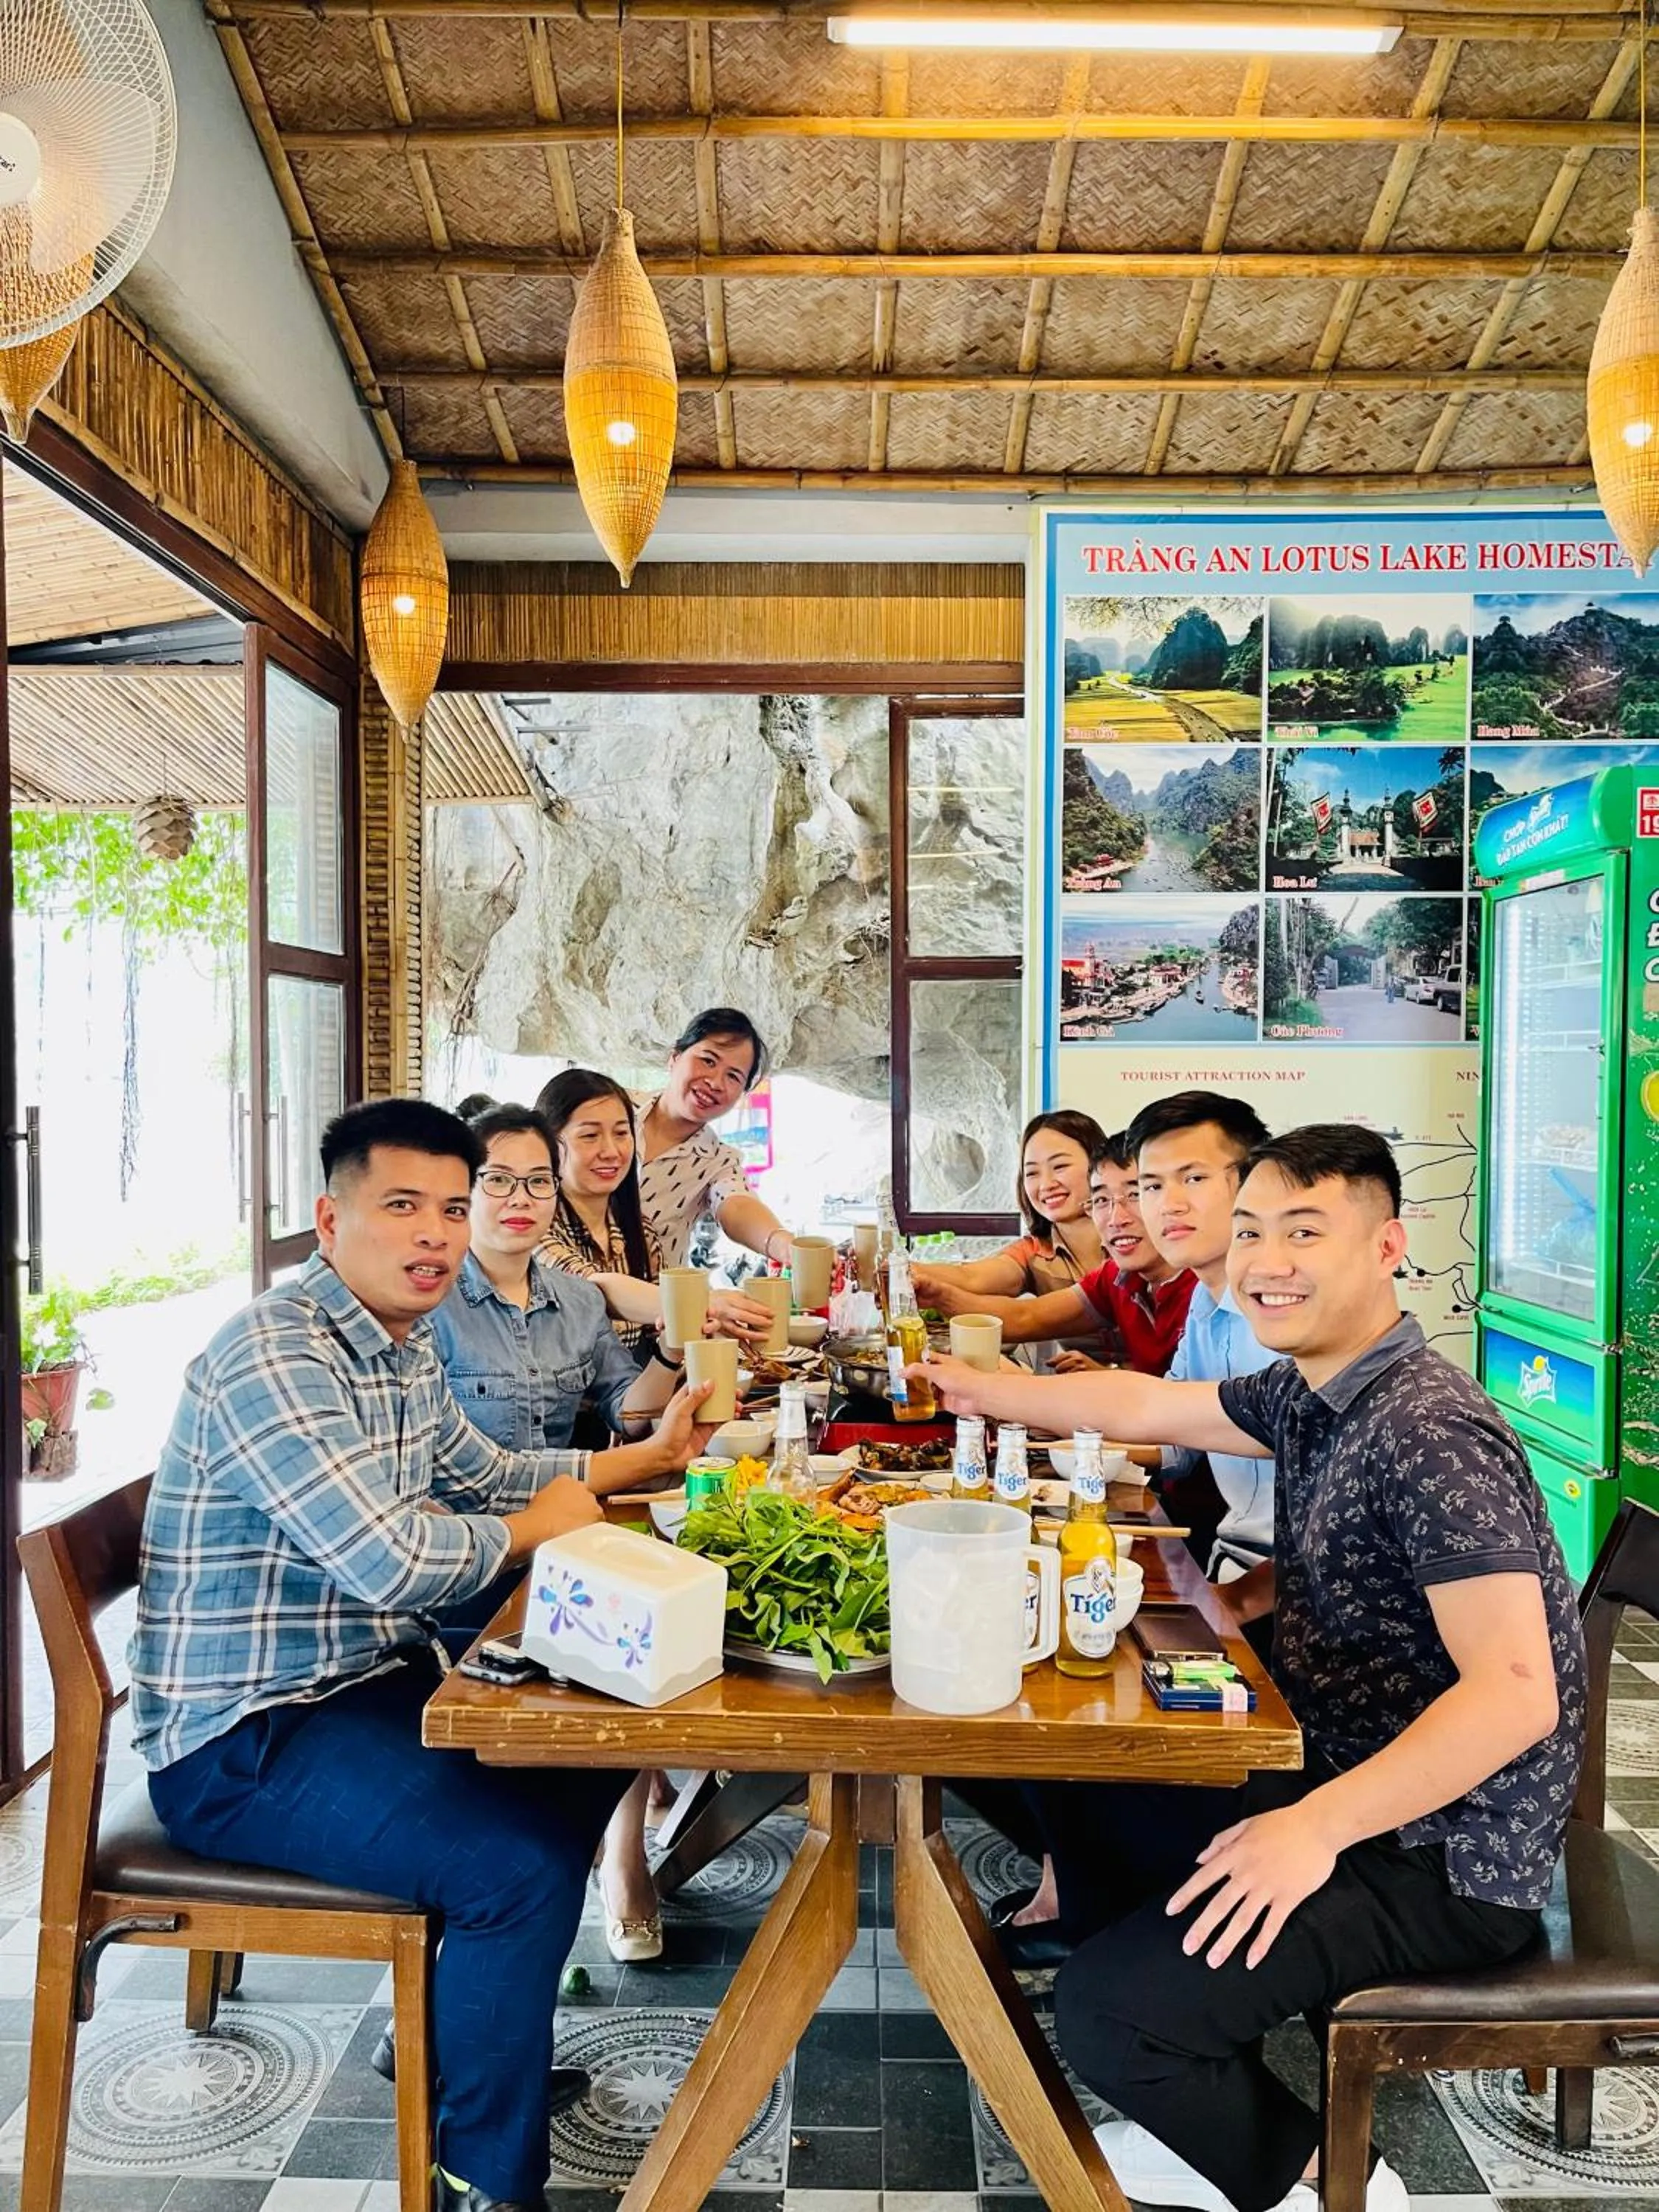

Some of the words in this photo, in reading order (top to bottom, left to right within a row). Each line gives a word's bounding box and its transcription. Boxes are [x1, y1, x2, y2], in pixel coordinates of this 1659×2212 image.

[1082, 539, 1197, 573] TRÀNG
[1205, 547, 1251, 572] AN
[1262, 546, 1370, 572] LOTUS
[1380, 544, 1466, 570] LAKE
[1478, 543, 1653, 569] HOMESTA
[1121, 1071, 1179, 1081] TOURIST
[1184, 1071, 1270, 1081] ATTRACTION
[1276, 1071, 1306, 1081] MAP
[958, 1462, 986, 1480] Tiger
[998, 1472, 1027, 1491] Tiger
